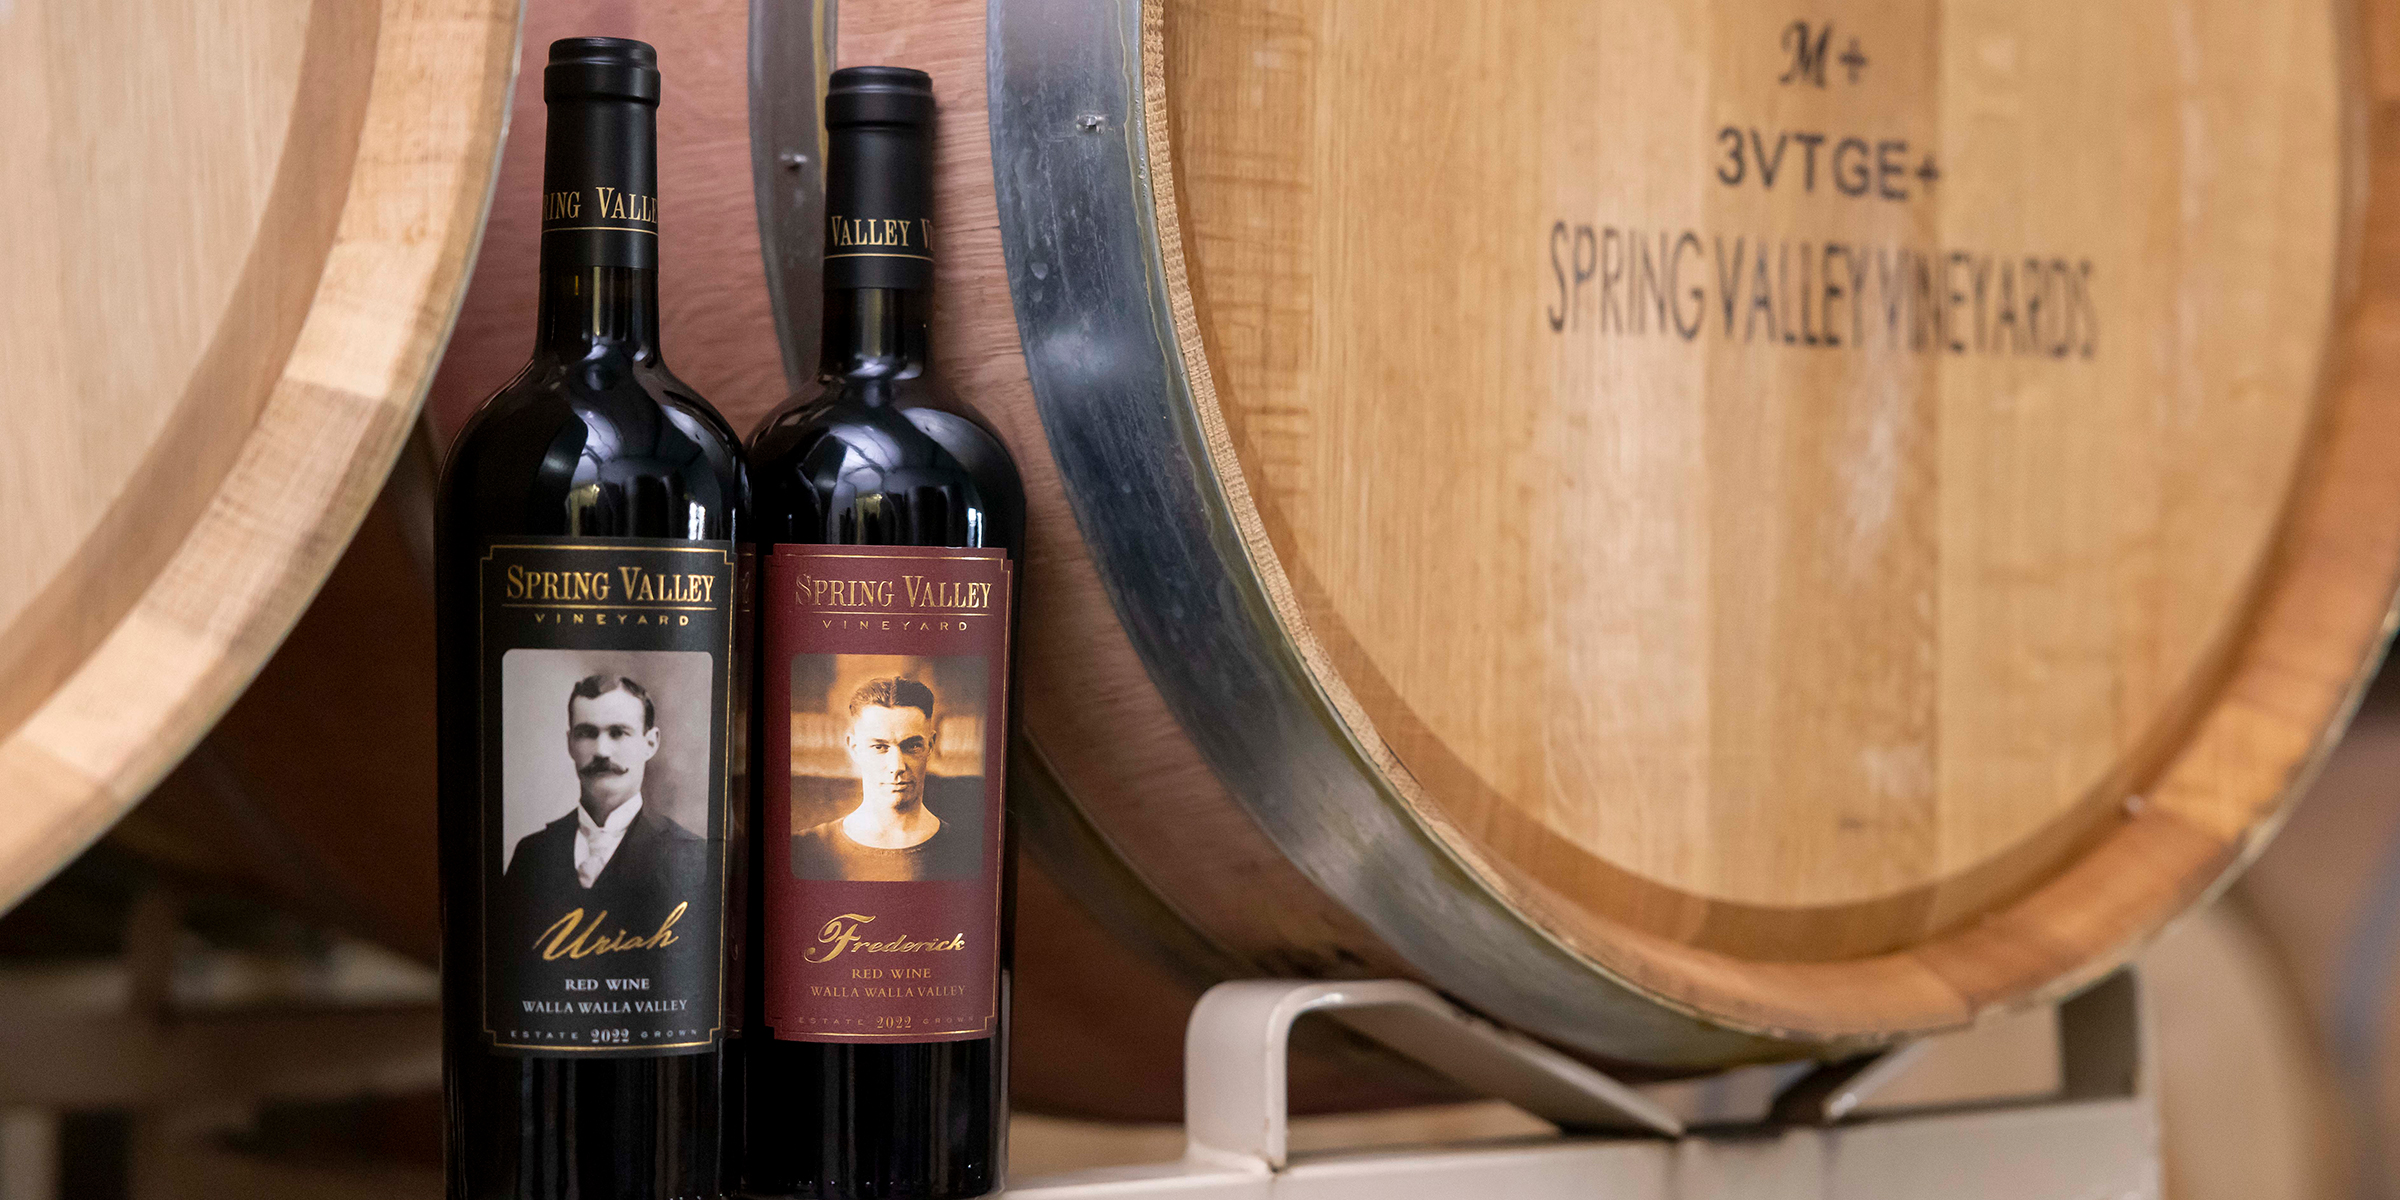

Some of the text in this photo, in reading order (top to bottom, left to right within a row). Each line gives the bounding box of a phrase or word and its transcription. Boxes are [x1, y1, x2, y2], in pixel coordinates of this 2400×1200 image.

[1716, 126, 1940, 201] 3VTGE+
[831, 215, 911, 247] VALLEY
[1548, 221, 2097, 361] SPRING VALLEY VINEYARDS
[507, 564, 611, 601] SPRING
[618, 566, 715, 602] VALLEY
[795, 573, 993, 609] SPRING VALLEY
[535, 613, 689, 626] VINEYARD
[822, 620, 967, 631] VINEYARD
[533, 901, 688, 961] Uriah
[804, 913, 966, 964] Frederick
[852, 968, 932, 979] RED WINE
[565, 978, 650, 991] RED WINE
[811, 985, 966, 998] WALLA WALLA VALLEY
[522, 1000, 688, 1014] WALLA WALLA VALLEY
[799, 1015, 975, 1029] ESTATE 2022 GROWN
[510, 1029, 698, 1043] ESTATE 2022 GROWN
